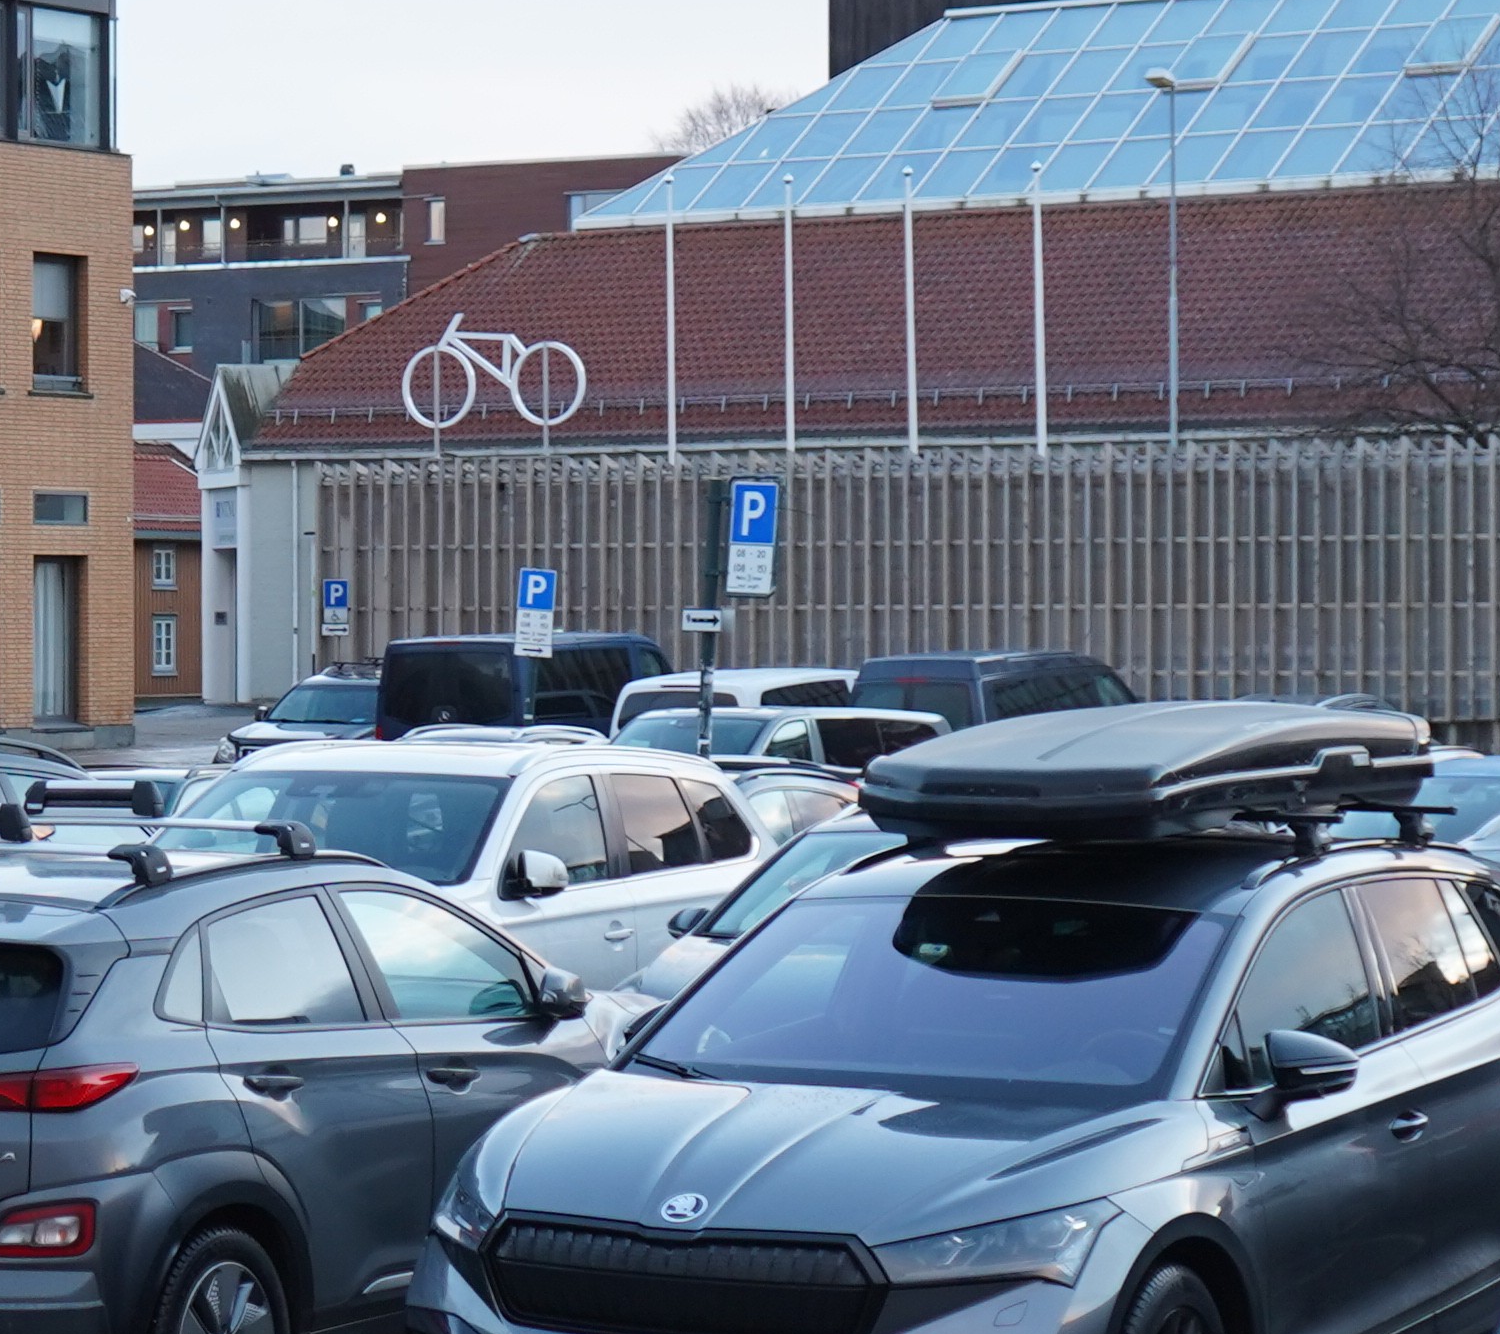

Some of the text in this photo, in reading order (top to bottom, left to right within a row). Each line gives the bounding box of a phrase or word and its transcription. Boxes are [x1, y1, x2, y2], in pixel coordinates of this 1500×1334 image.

[741, 490, 766, 536] P
[330, 583, 344, 605] P
[526, 574, 547, 605] P
